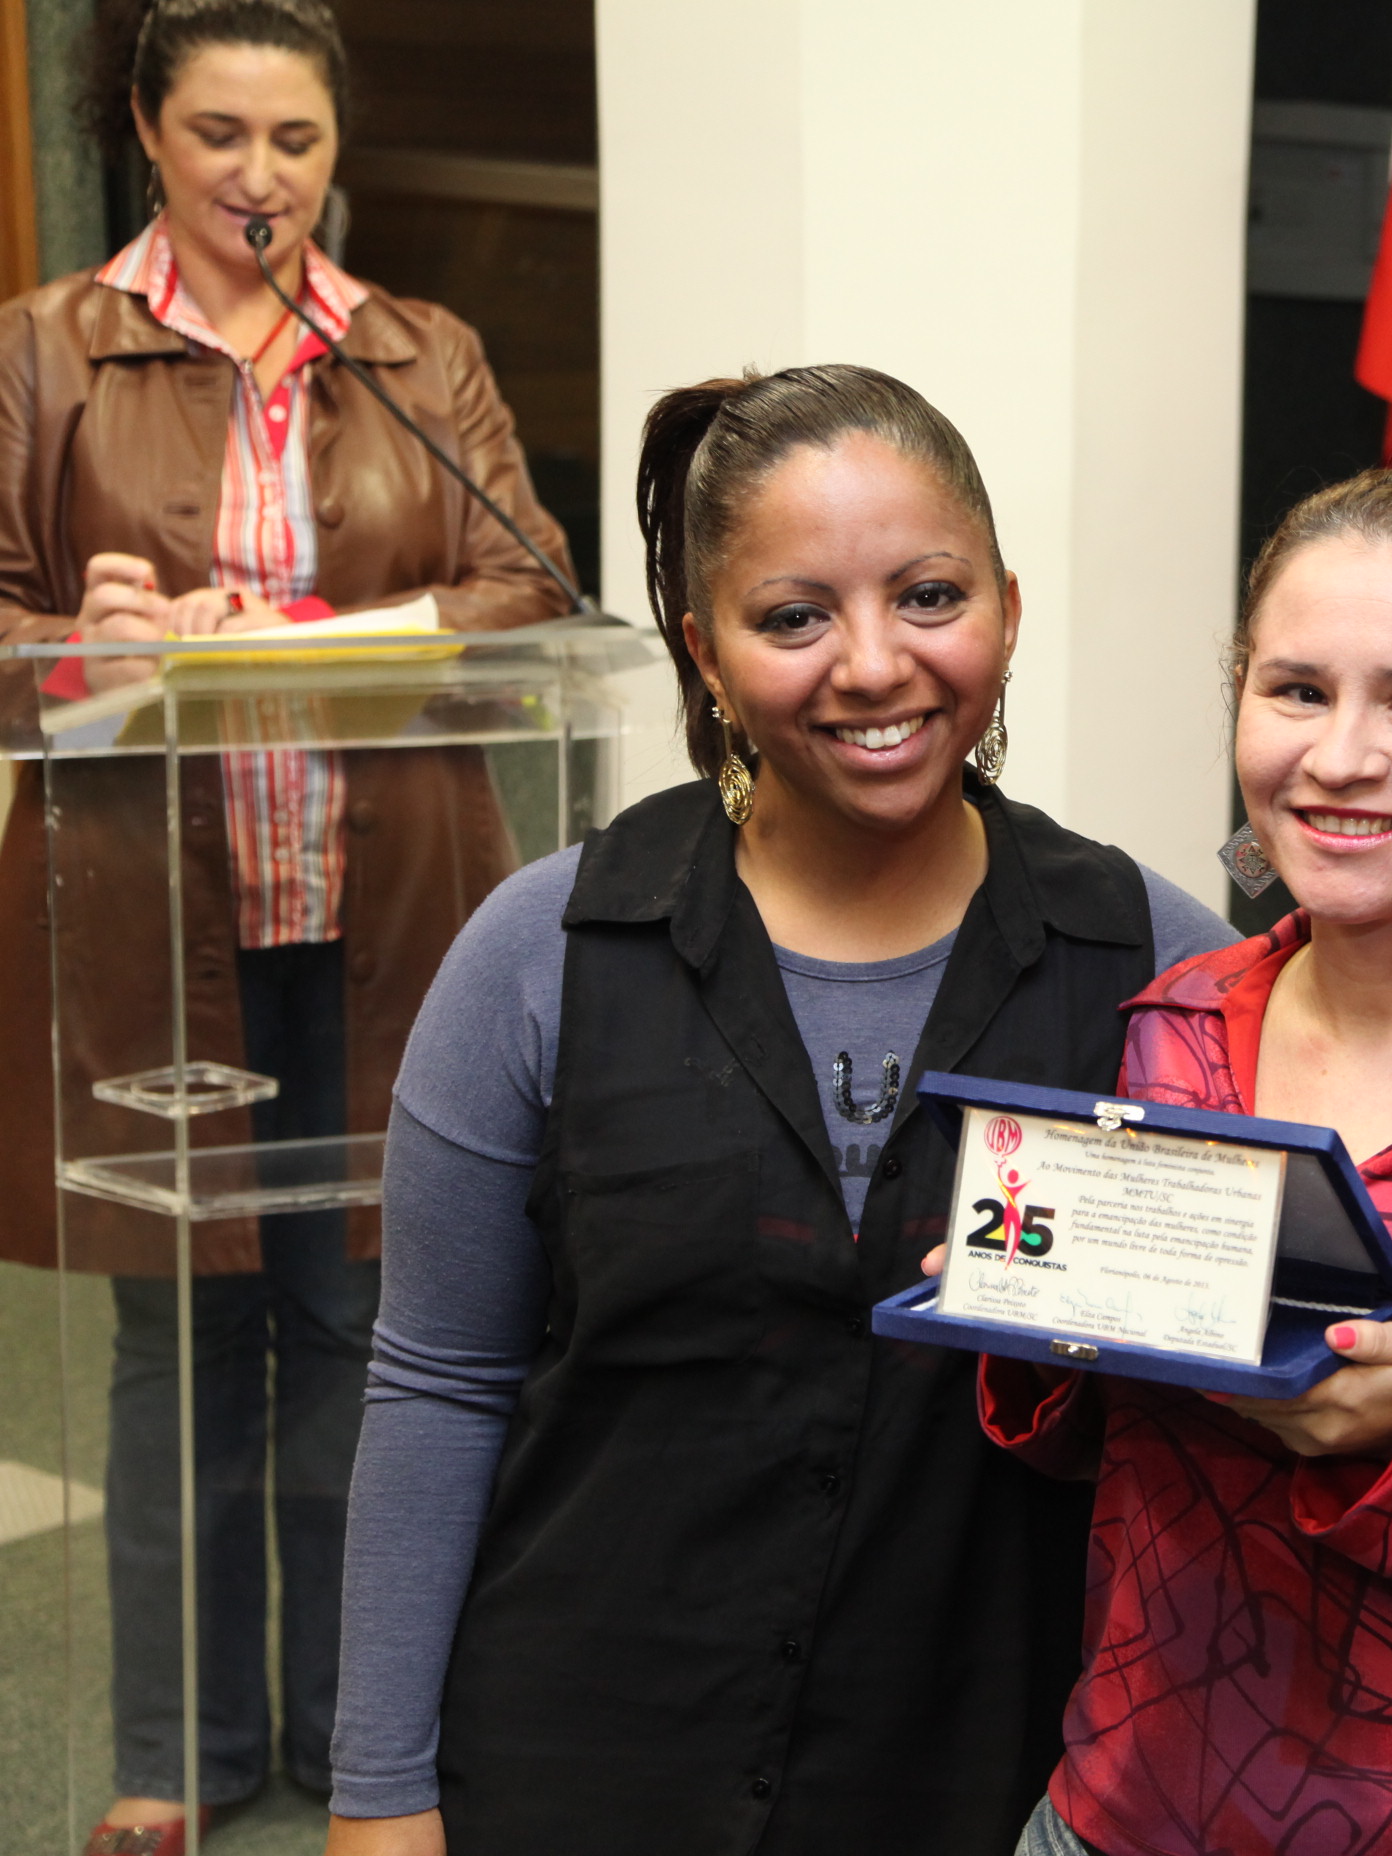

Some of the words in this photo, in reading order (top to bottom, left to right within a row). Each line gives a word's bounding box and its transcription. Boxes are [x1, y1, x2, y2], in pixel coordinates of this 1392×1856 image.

[986, 1118, 1019, 1153] UBM
[1044, 1129, 1102, 1148] Homenagem
[1105, 1137, 1117, 1148] da
[1121, 1139, 1150, 1152] União
[1152, 1144, 1199, 1159] Brasileira
[1201, 1150, 1213, 1161] de
[1085, 1151, 1100, 1159] Uma
[1102, 1154, 1136, 1164] homenagem
[1037, 1161, 1050, 1170] Ao
[1053, 1162, 1101, 1177] Movimento
[1103, 1169, 1118, 1179] das
[1120, 1172, 1159, 1185] Mulheres
[1161, 1178, 1222, 1195] Trabalhadoras
[1225, 1187, 1261, 1200] Urbanas
[1078, 1195, 1095, 1204] Pela
[1096, 1199, 1128, 1209] parceria
[1130, 1204, 1143, 1212] nos
[1145, 1205, 1181, 1217] trabalhos
[1189, 1212, 1209, 1222] ações
[1121, 1187, 1174, 1203] MMTU/SC
[966, 1198, 1056, 1257] 25
[1069, 1219, 1120, 1235] fundamental
[1133, 1229, 1150, 1239] luta
[1151, 1233, 1168, 1242] pela
[1170, 1237, 1219, 1249] emancipação
[1071, 1209, 1089, 1218] para
[1098, 1212, 1146, 1225] emancipação
[1148, 1218, 1162, 1228] das
[1201, 1228, 1222, 1236] como
[1223, 1231, 1257, 1242] condição
[968, 1250, 992, 1260] ANOS
[995, 1254, 1006, 1262] DE
[1013, 1257, 1068, 1271] CONQUISTAS
[1072, 1235, 1085, 1244] por
[1101, 1239, 1127, 1249] mundo
[1129, 1241, 1146, 1252] livre
[1148, 1244, 1157, 1253] de
[1160, 1246, 1177, 1257] toda
[1177, 1248, 1202, 1260] forma
[1203, 1252, 1213, 1261] de
[962, 1303, 1005, 1315] Coordenadora
[1052, 1316, 1095, 1329] Coordenadora
